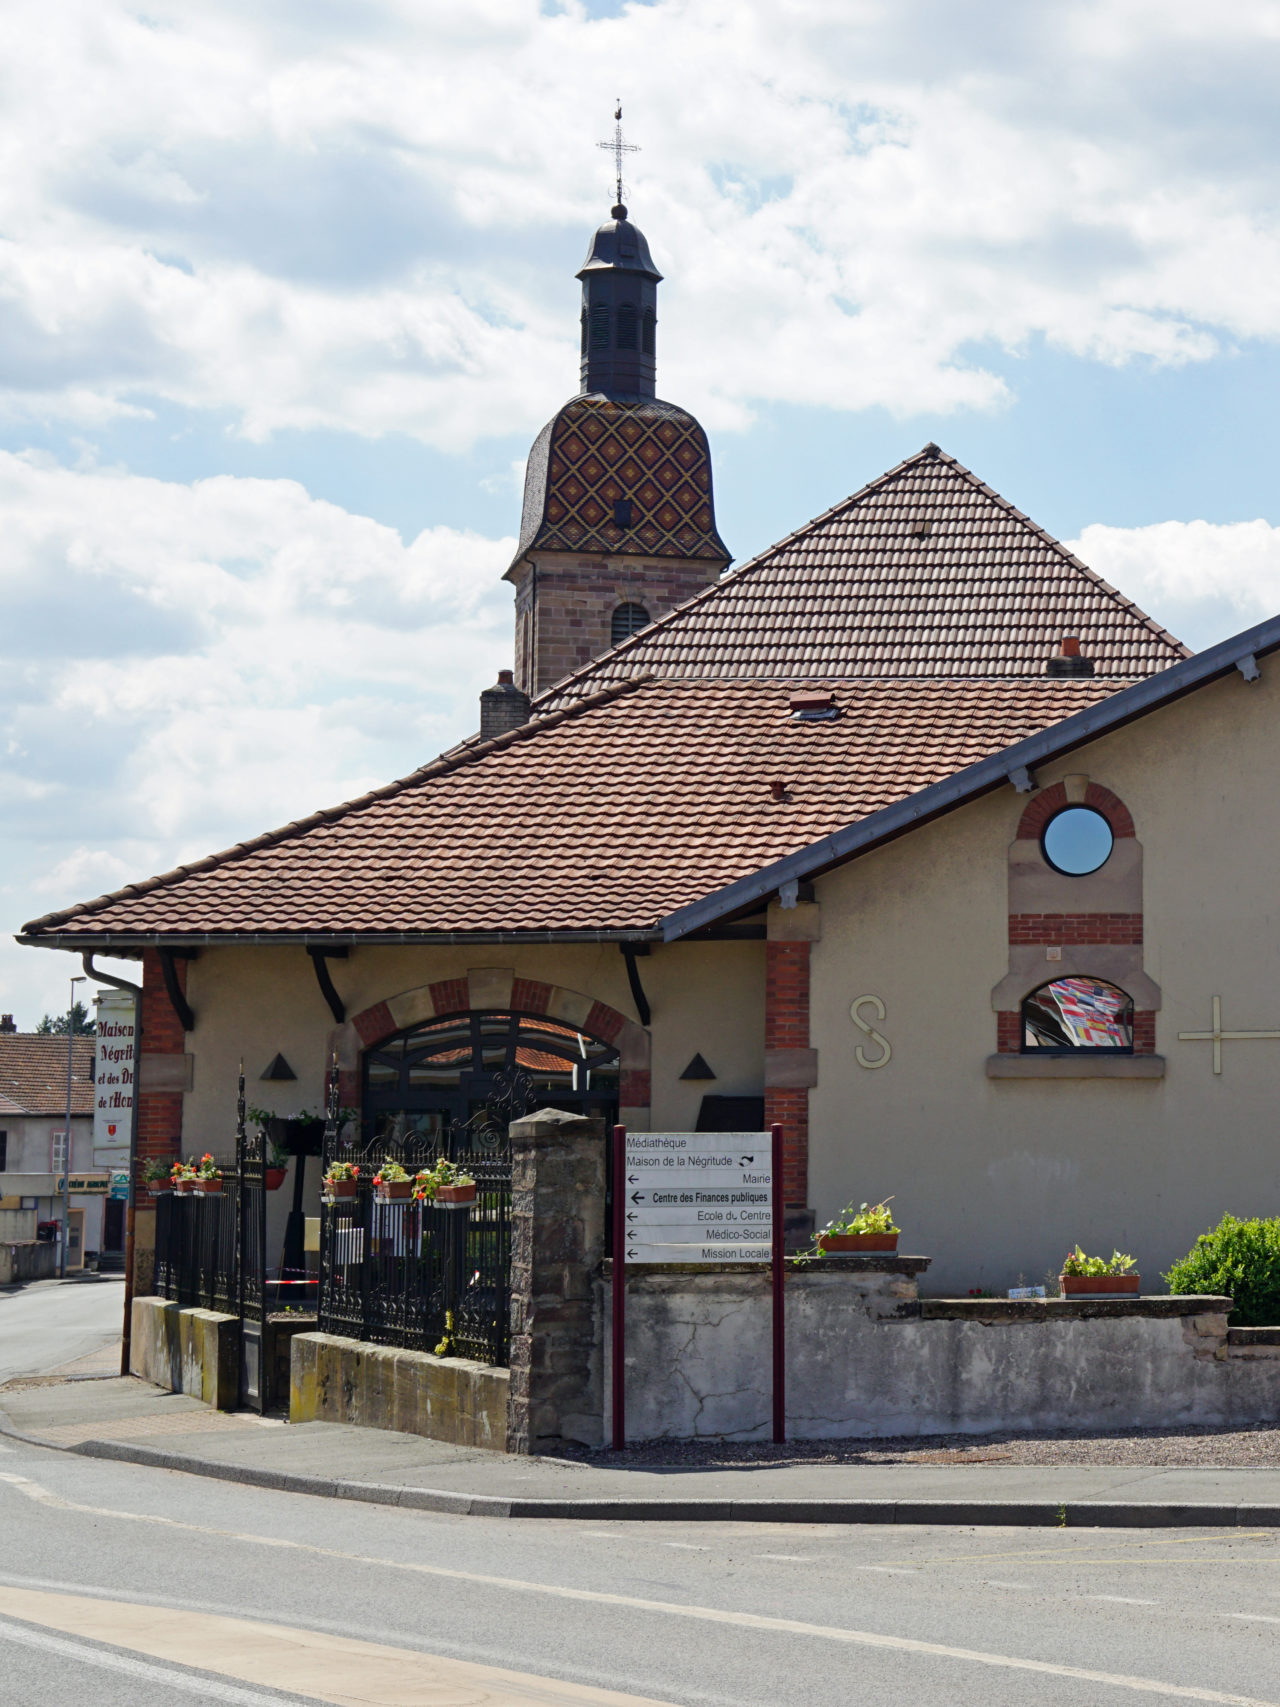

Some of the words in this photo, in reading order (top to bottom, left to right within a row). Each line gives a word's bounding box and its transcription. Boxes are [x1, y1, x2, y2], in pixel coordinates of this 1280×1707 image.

[97, 1021, 134, 1038] Maison
[101, 1044, 133, 1064] Négrit
[98, 1072, 106, 1085] et
[107, 1072, 119, 1085] des
[98, 1096, 107, 1109] de
[626, 1137, 688, 1151] Médiathèque
[626, 1155, 661, 1167] Maison
[662, 1155, 675, 1167] de
[677, 1155, 686, 1167] la
[688, 1155, 734, 1169] Négritude
[742, 1173, 771, 1184] Mairie
[652, 1192, 679, 1204] Centre
[679, 1192, 694, 1204] des
[695, 1192, 730, 1203] Finances
[730, 1191, 768, 1206] publiques
[725, 1210, 738, 1222] du
[740, 1210, 771, 1222] Centre
[706, 1228, 771, 1240] Médico-Social
[701, 1247, 737, 1260] Mission
[739, 1247, 770, 1260] Locale
